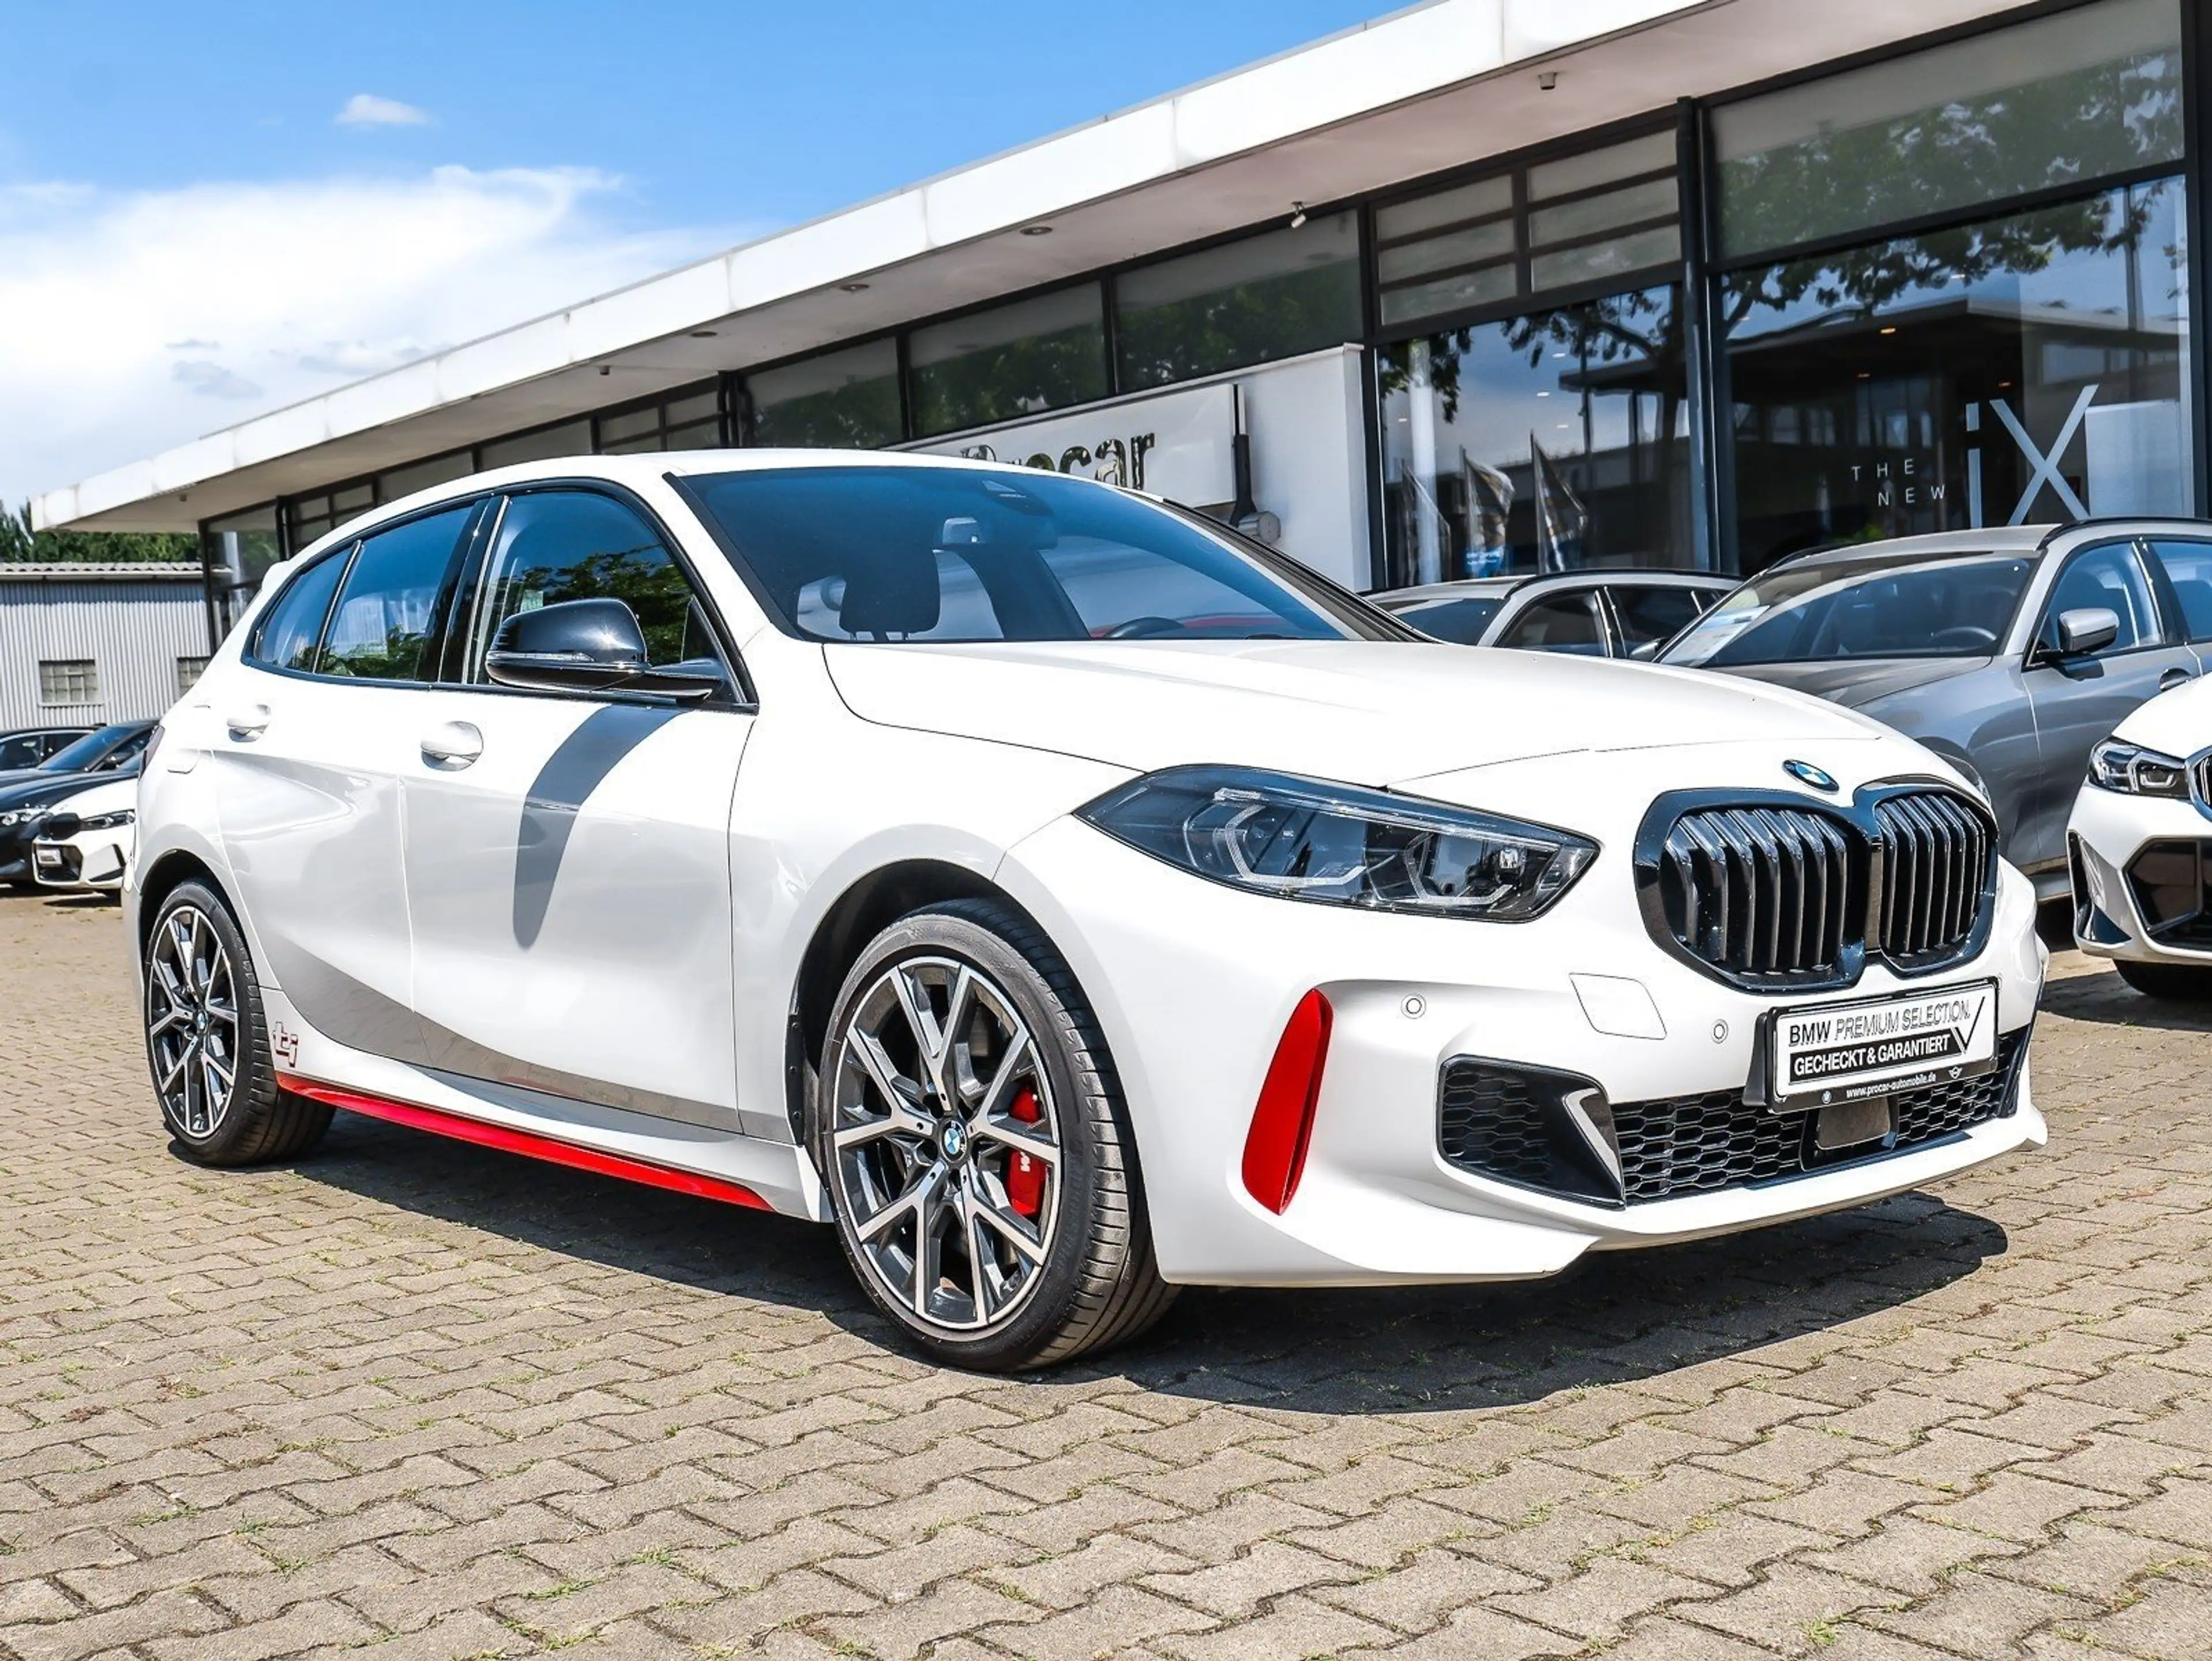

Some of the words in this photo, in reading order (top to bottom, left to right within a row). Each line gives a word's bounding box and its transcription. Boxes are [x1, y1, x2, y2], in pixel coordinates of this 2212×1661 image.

[1852, 459, 1914, 480] THE
[1966, 384, 2099, 528] iX
[1879, 484, 1945, 506] NEW
[271, 1021, 298, 1067] ti
[1789, 1020, 1831, 1046] BMW
[1834, 1012, 1899, 1040] PREMIUM
[1794, 1048, 1867, 1076] GECHECKT
[1867, 1048, 1877, 1064] &
[1877, 1035, 1950, 1062] GARANTIERT
[1846, 1072, 1936, 1098] www.procar-automobile.de
